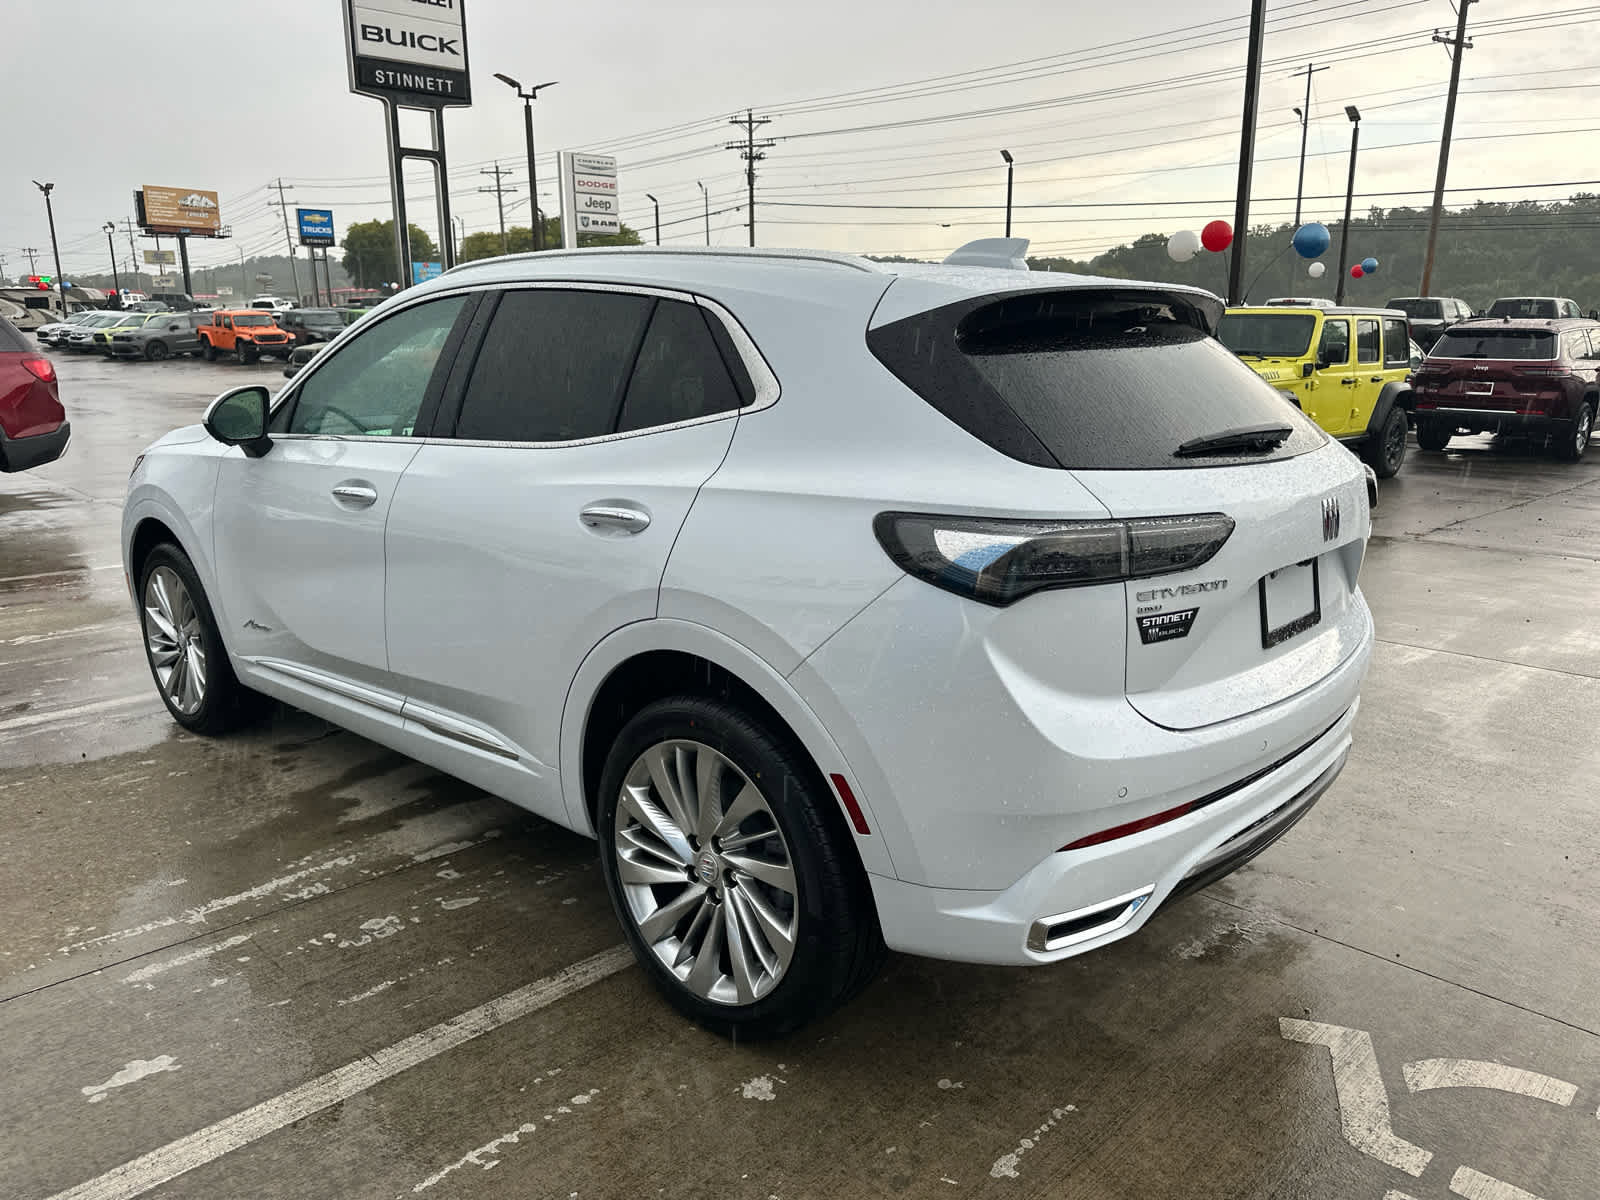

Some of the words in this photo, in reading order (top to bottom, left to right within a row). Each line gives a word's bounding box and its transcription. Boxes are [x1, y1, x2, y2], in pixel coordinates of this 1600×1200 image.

[361, 24, 460, 56] BUICK
[375, 69, 454, 93] STINNETT
[577, 180, 616, 189] DODGE
[585, 196, 612, 211] Jeep
[302, 226, 332, 234] TRUCKS
[592, 219, 618, 227] RAM
[1142, 611, 1194, 627] STINNETT
